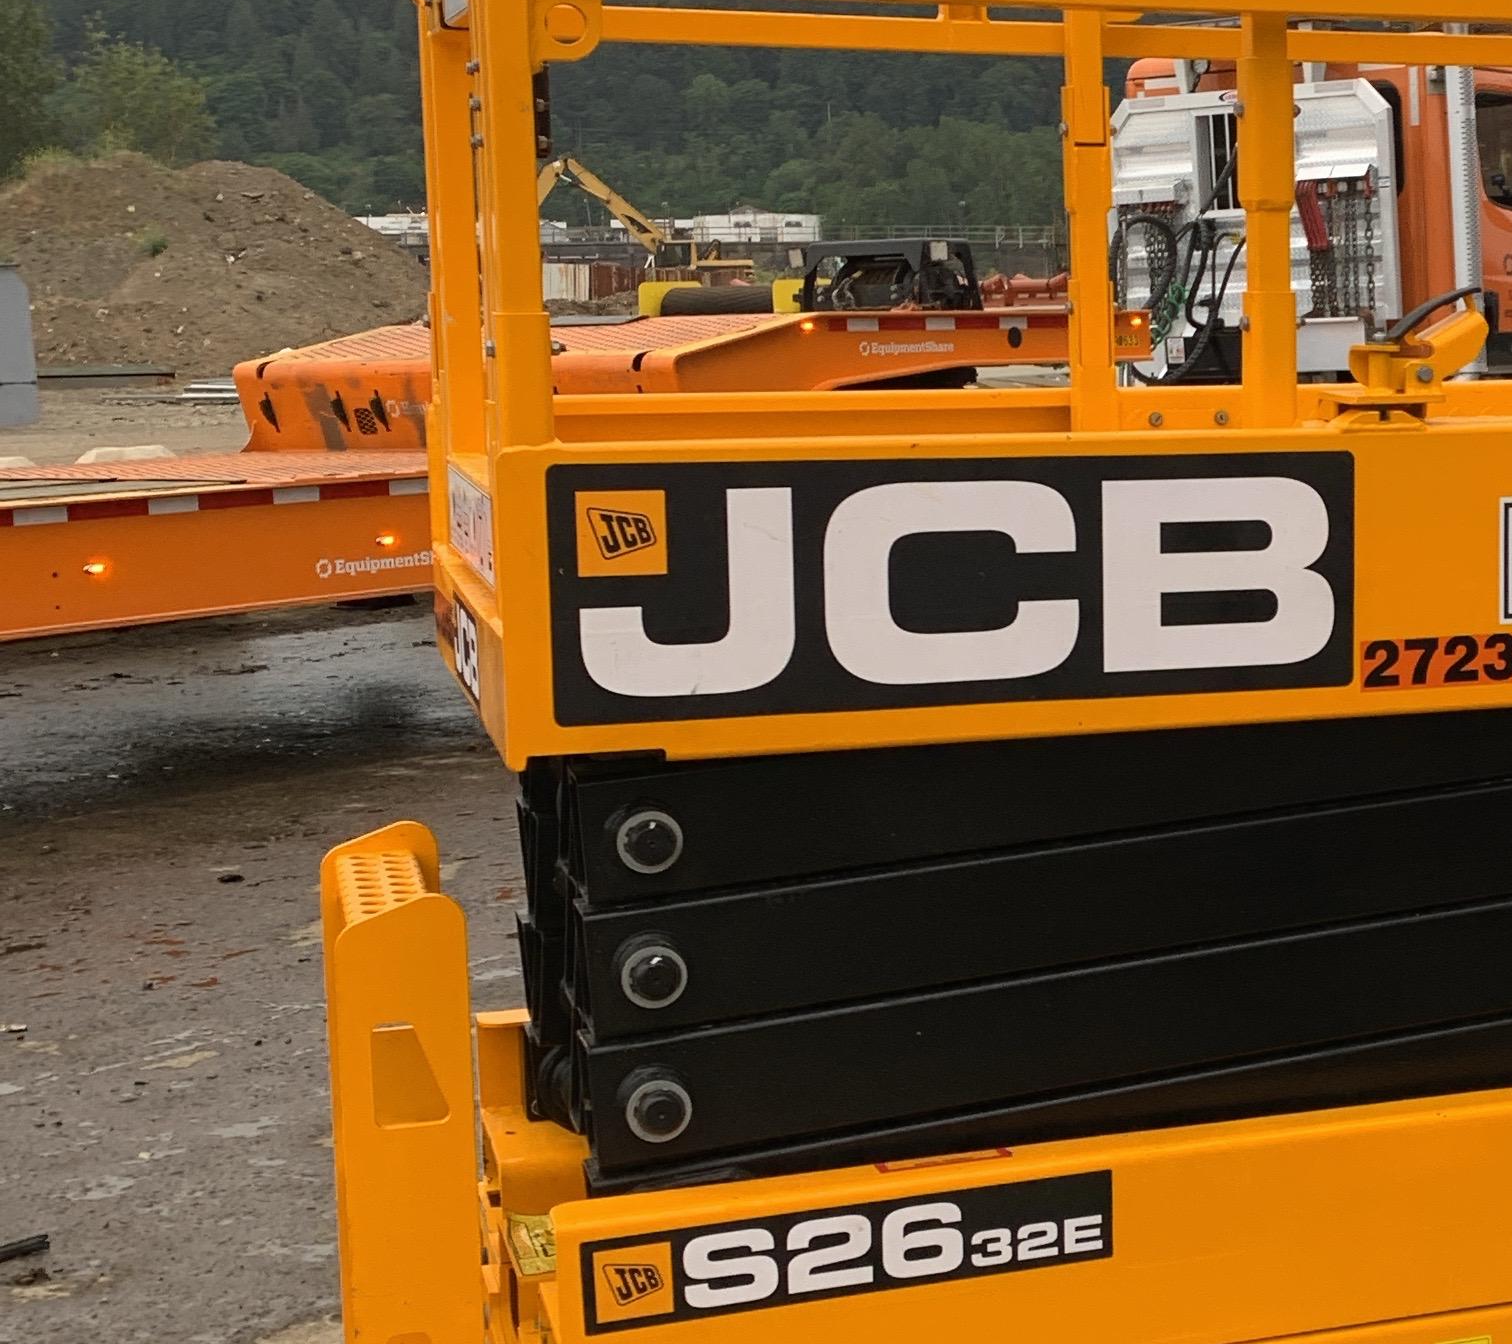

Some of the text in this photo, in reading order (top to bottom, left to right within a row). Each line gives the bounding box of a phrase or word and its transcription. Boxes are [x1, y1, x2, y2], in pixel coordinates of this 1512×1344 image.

[599, 513, 652, 554] JCB
[580, 476, 1335, 697] JCB
[613, 1268, 660, 1301] JCB
